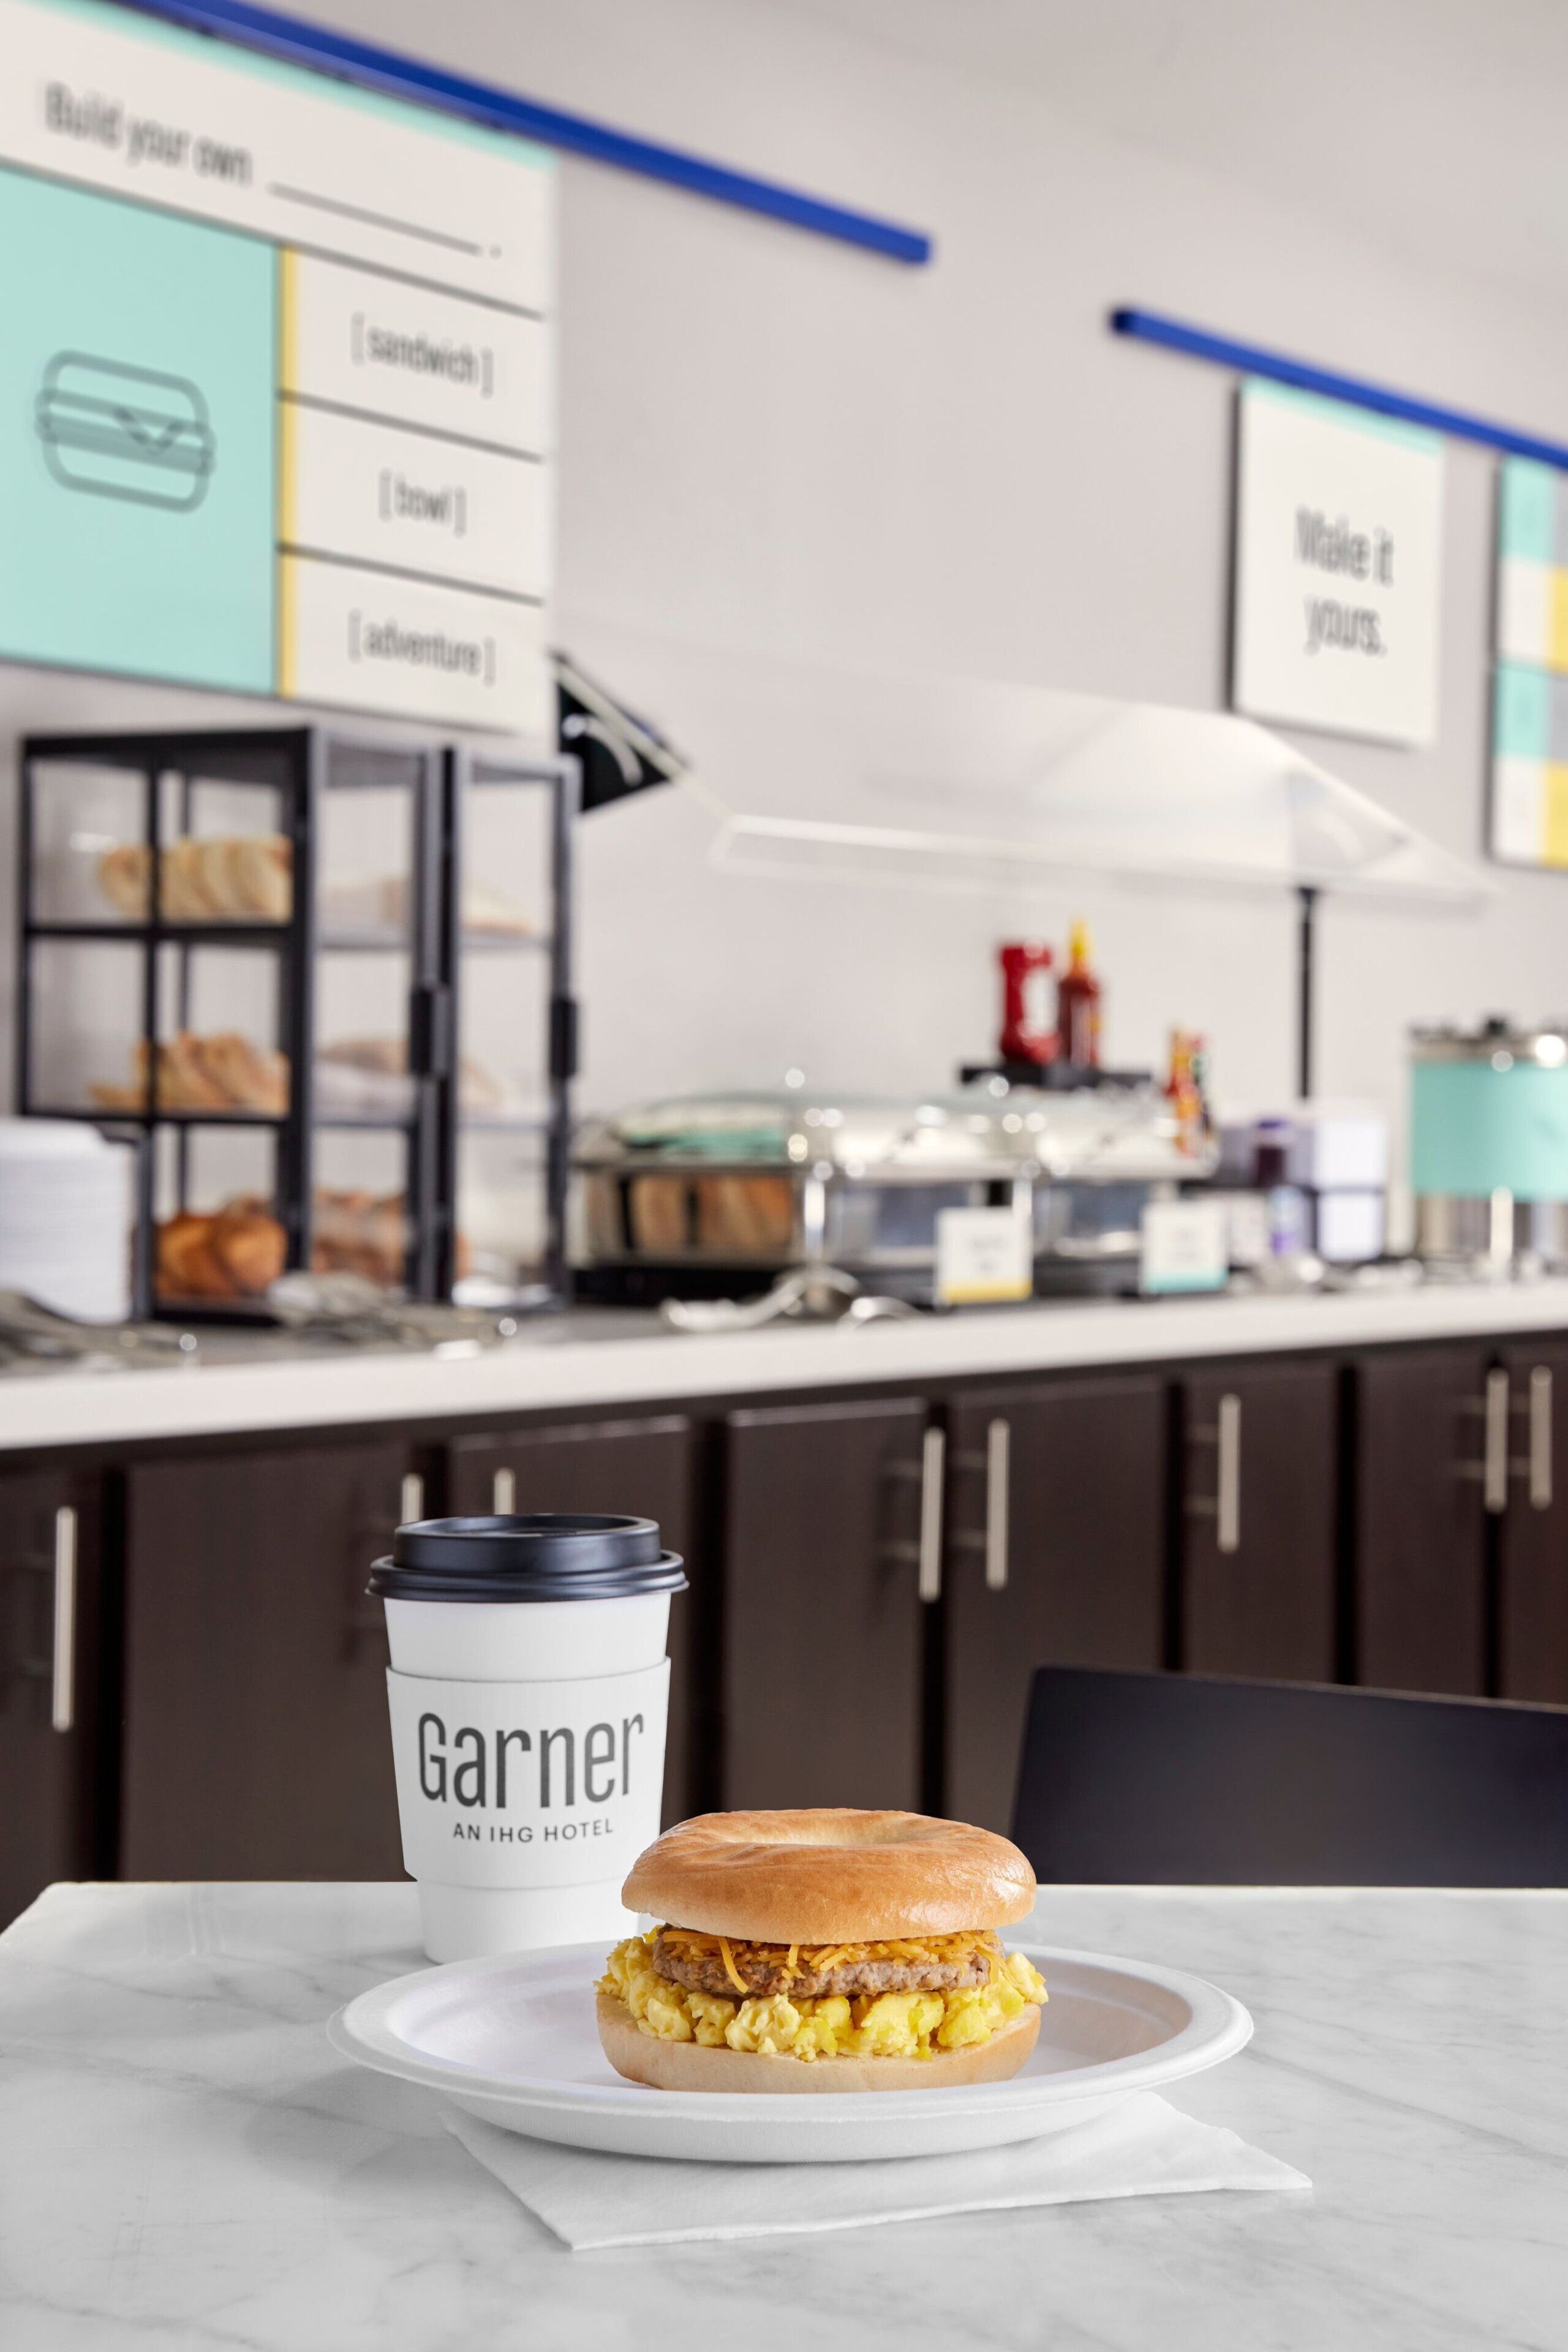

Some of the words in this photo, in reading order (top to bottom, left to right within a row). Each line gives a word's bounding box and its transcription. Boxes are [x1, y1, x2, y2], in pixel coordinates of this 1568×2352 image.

[44, 81, 122, 149] Build
[124, 116, 190, 165] your
[192, 138, 252, 185] own
[1294, 505, 1370, 581] Make
[1372, 524, 1395, 589] it
[1303, 595, 1388, 657] yours.
[418, 1713, 644, 1809] Garner
[453, 1822, 480, 1841] AN
[490, 1826, 533, 1844] IHG
[545, 1818, 613, 1841] HOTEL
